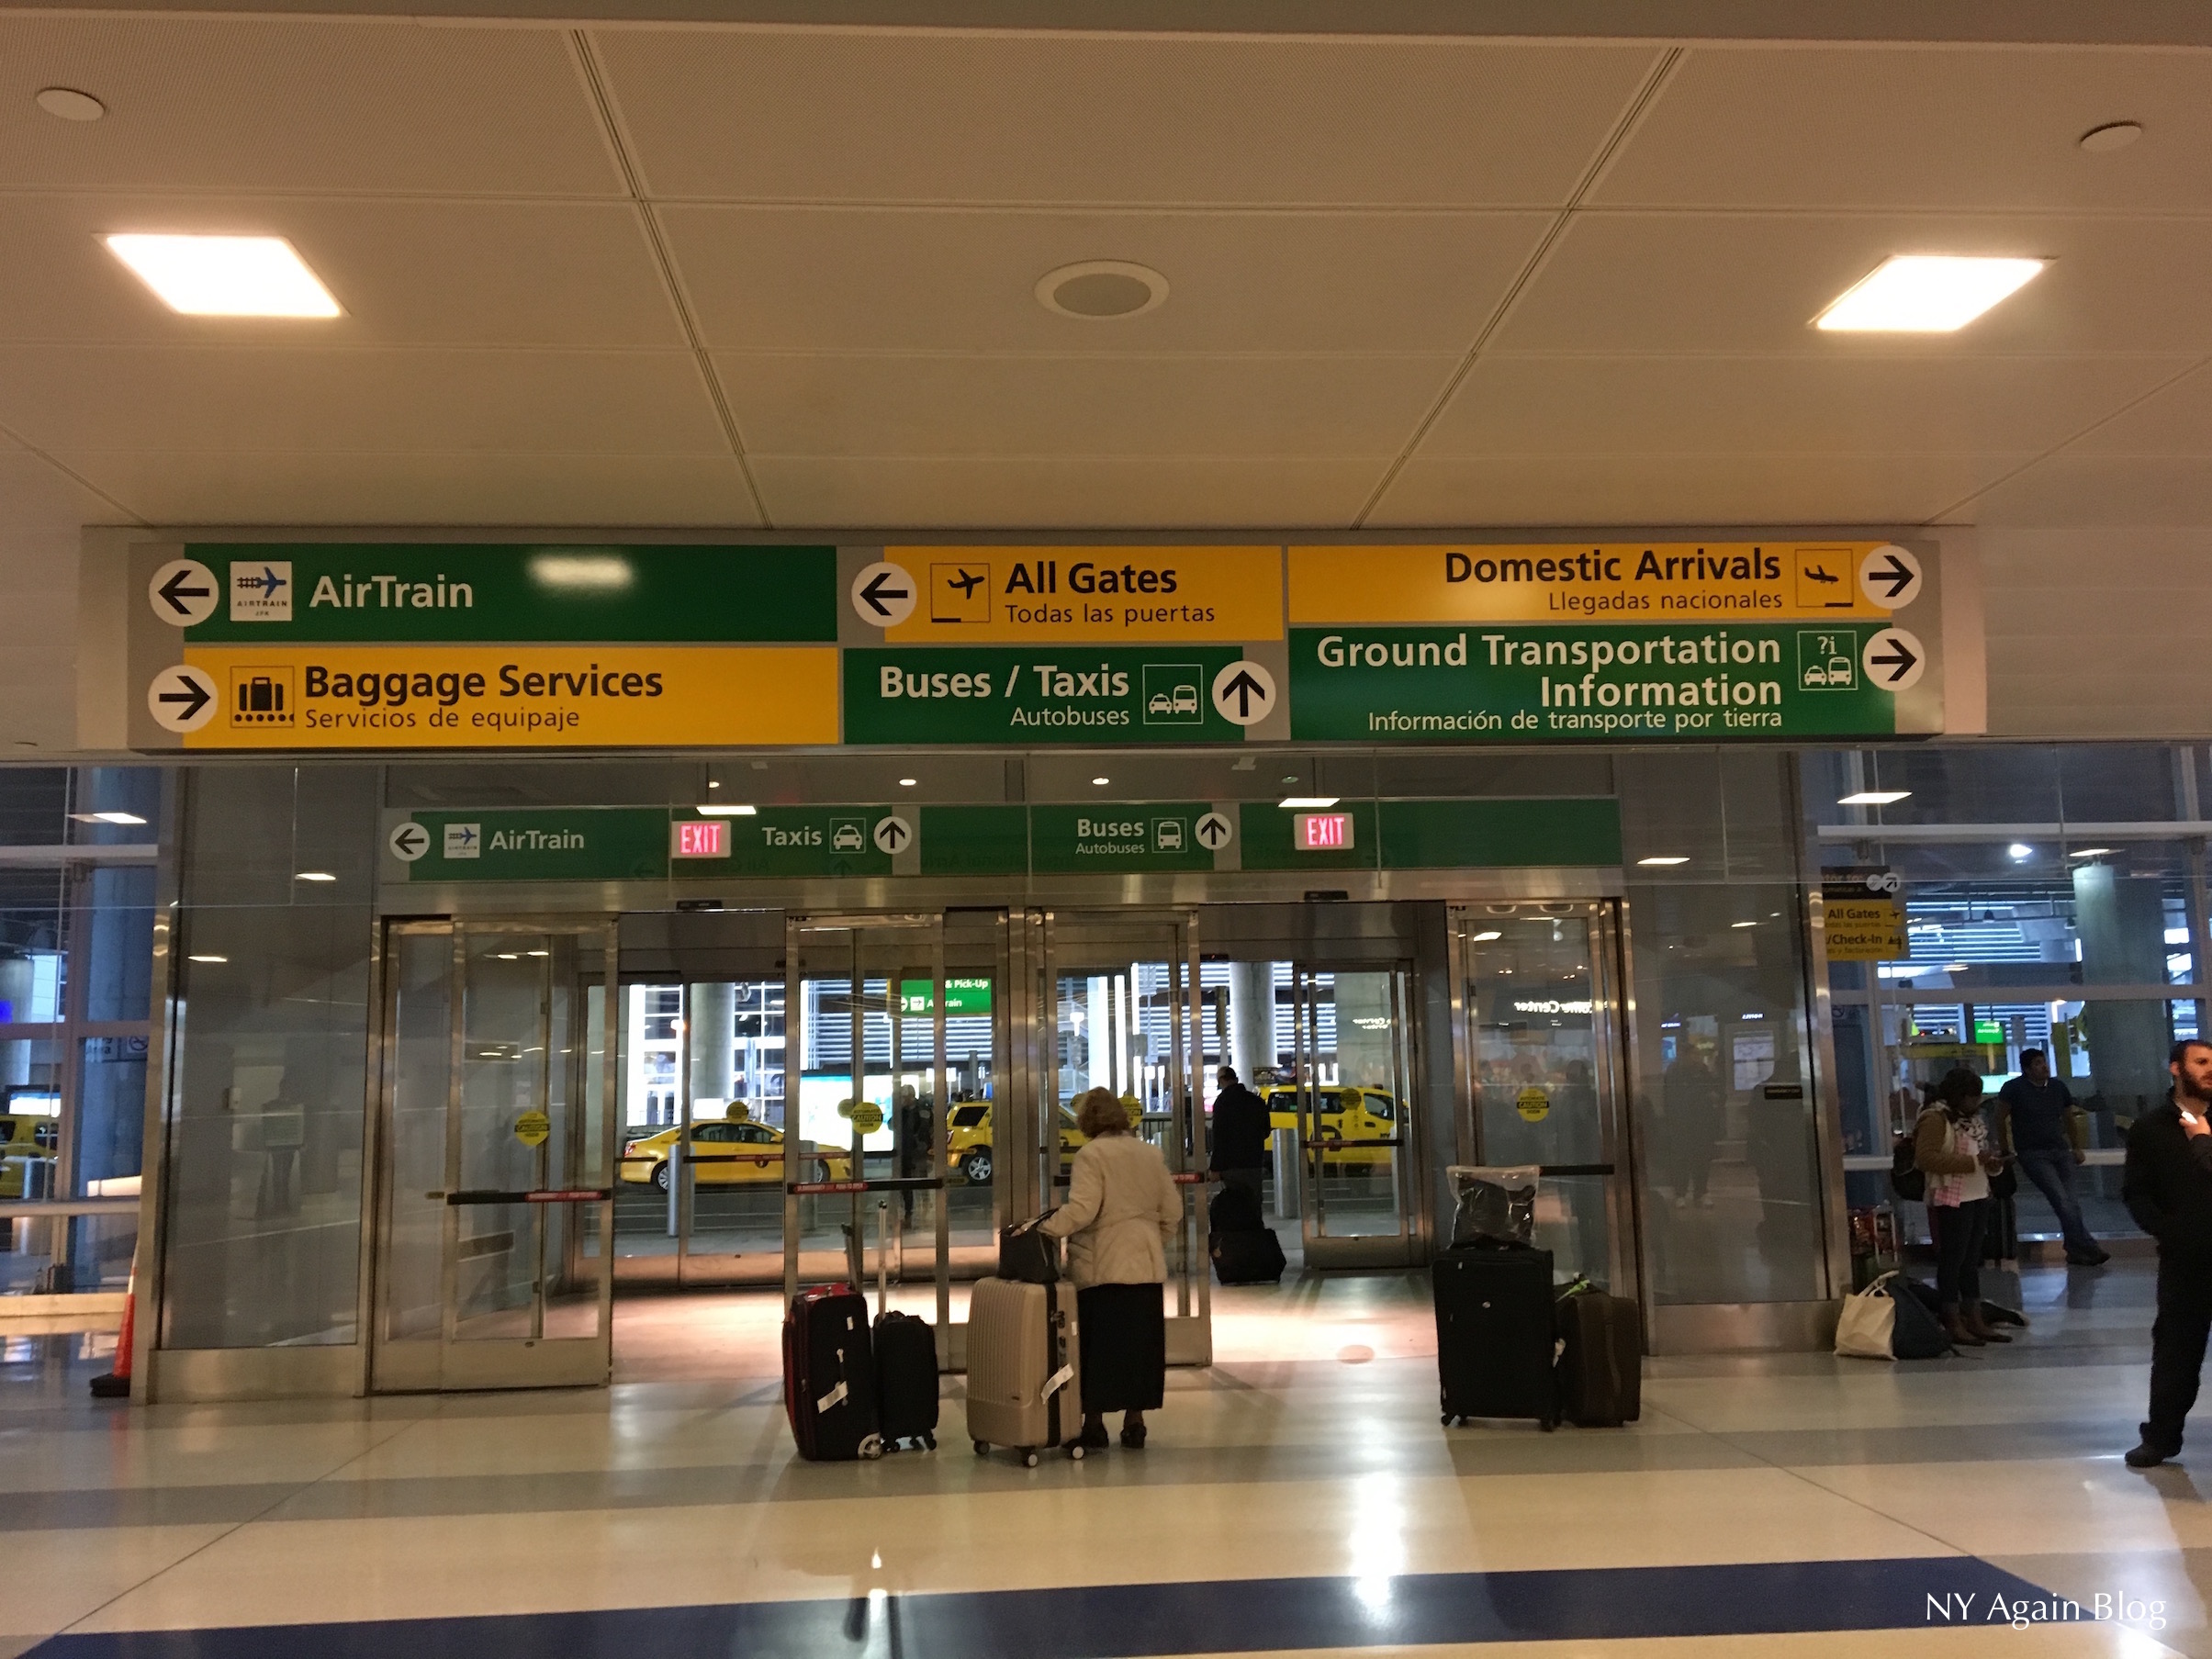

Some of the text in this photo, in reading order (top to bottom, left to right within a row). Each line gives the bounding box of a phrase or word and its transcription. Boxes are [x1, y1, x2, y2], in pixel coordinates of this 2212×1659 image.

[1005, 562, 1177, 594] All Gates
[1446, 548, 1781, 583] Domestic Arrivals
[309, 575, 473, 609] AirTrain
[1549, 590, 1782, 614] Llegadas nacionales
[1005, 603, 1215, 626] Todas las puertas
[1318, 634, 1780, 672] Ground Transportation
[306, 664, 663, 706] Baggage Services
[881, 665, 1129, 699] Buses / Taxis
[1542, 676, 1781, 707] Information
[306, 707, 580, 732] Servicios de equipaje
[1010, 706, 1130, 726] Autobuses
[1369, 709, 1782, 734] Información de transporte por tierra
[488, 829, 585, 850] AirTrain
[680, 824, 722, 853] EXIT
[762, 826, 823, 846] Taxis
[1077, 819, 1145, 837] Buses
[1307, 817, 1345, 846] EXIT
[1075, 842, 1145, 855] Autobuses
[1828, 909, 1881, 919] All Gates
[945, 979, 988, 990] & Pick-Up
